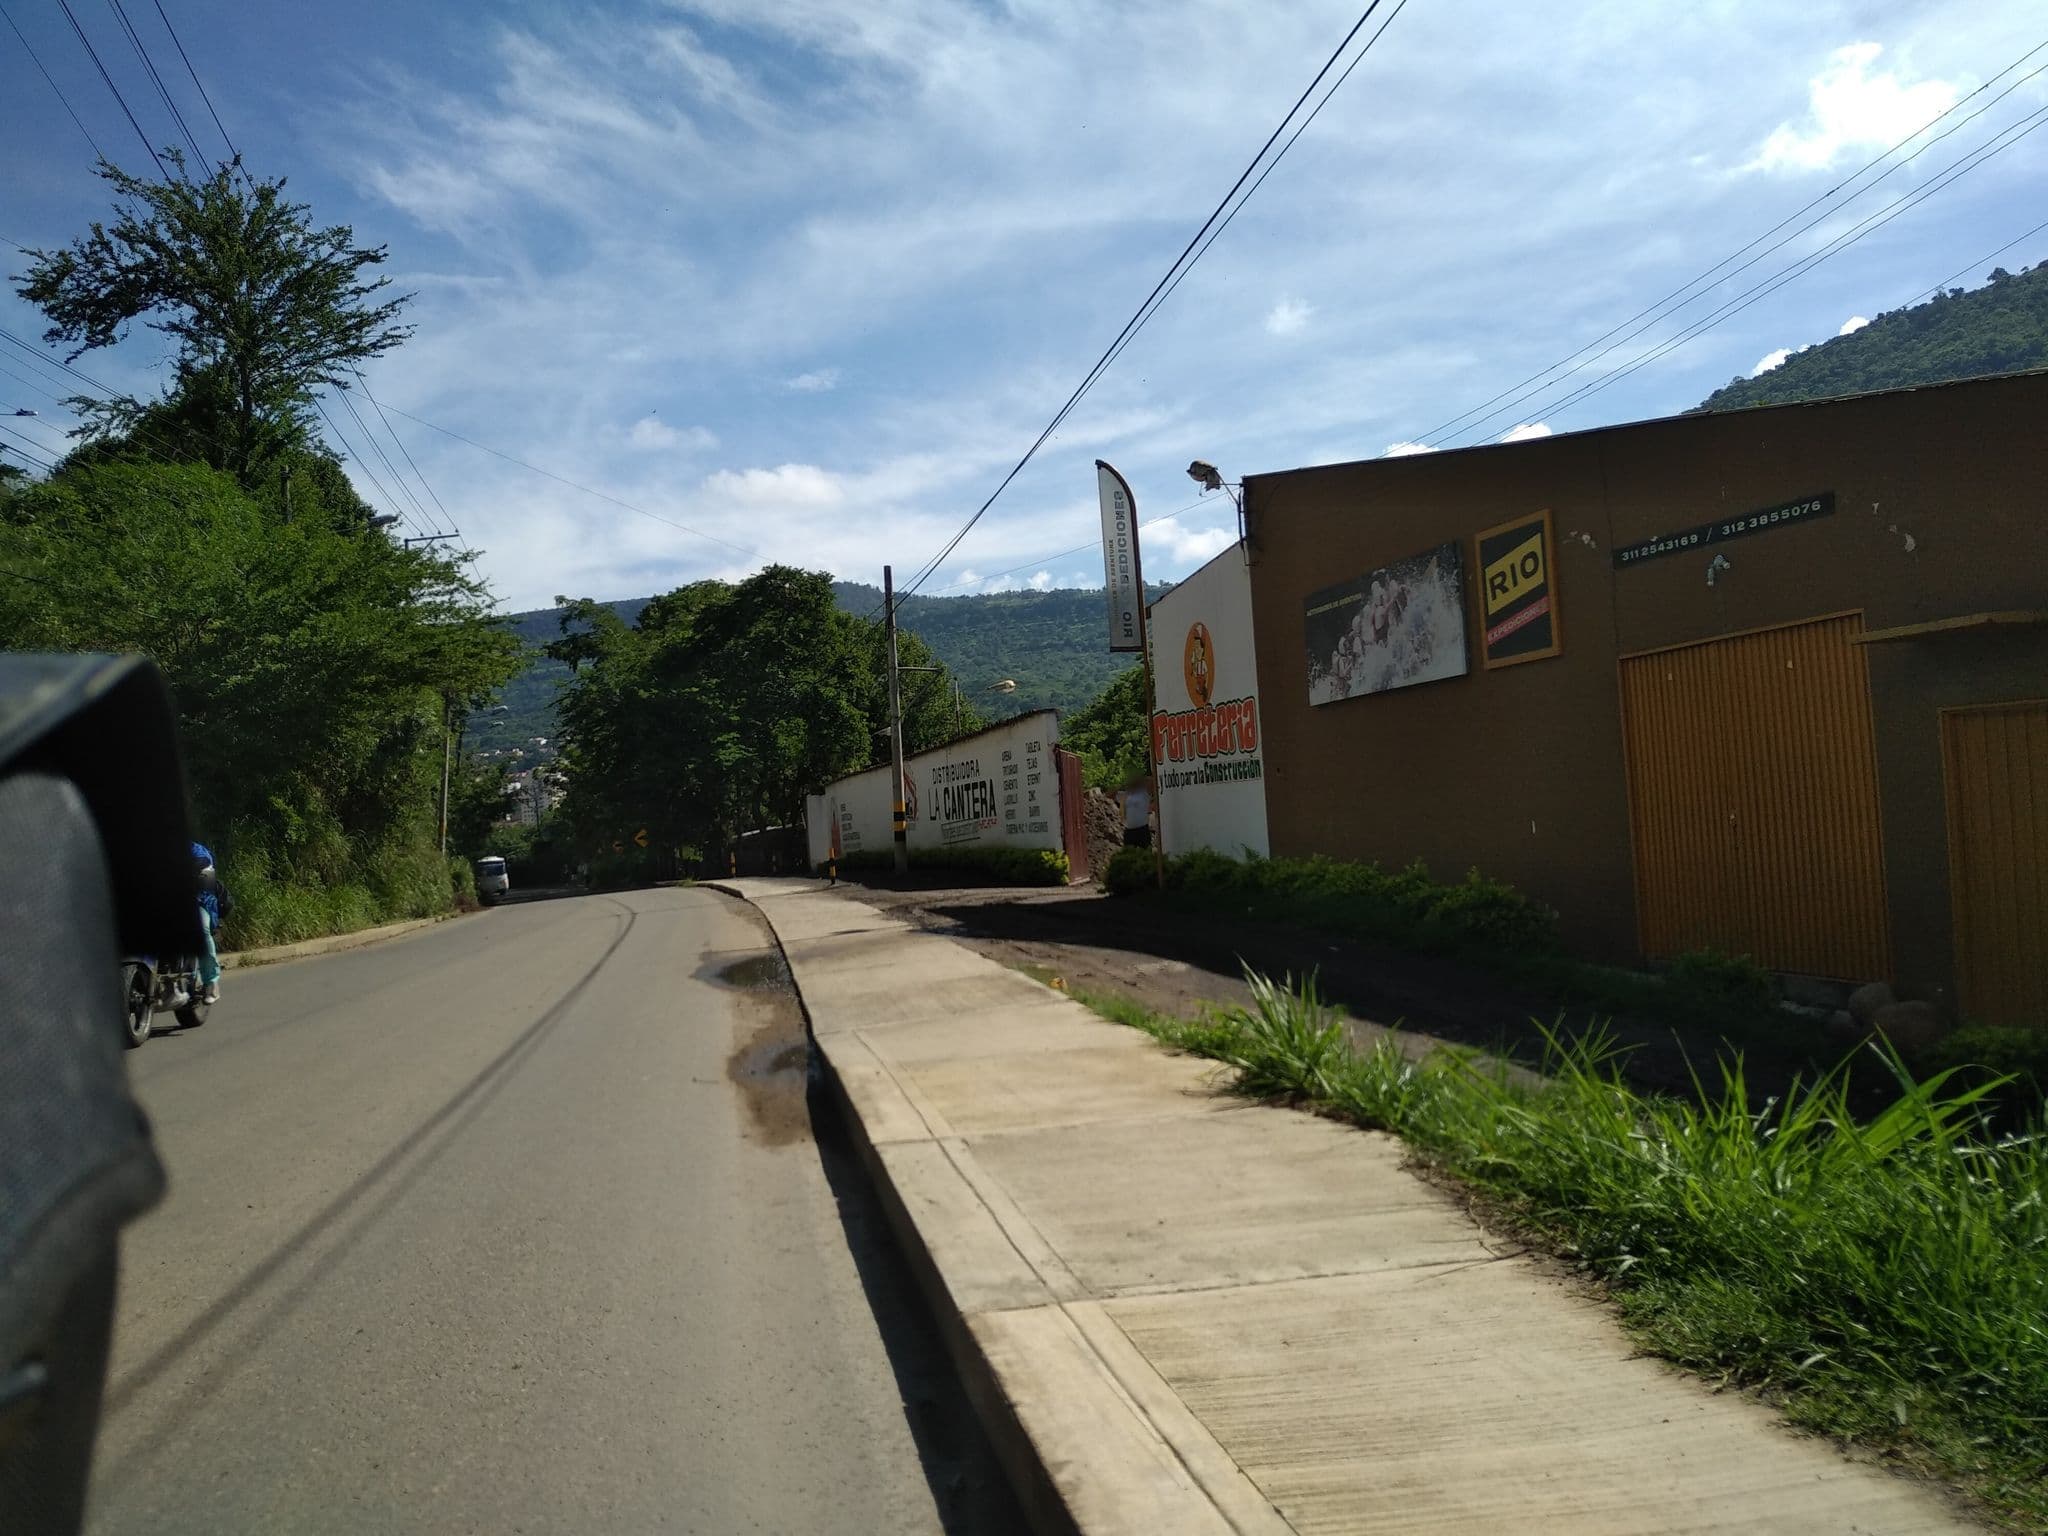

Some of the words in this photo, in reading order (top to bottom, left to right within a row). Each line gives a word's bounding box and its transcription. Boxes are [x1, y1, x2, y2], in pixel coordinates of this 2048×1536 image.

[1621, 534, 1698, 561] 3112543169
[1722, 521, 1745, 535] 312
[1749, 500, 1821, 528] 3855076
[1489, 551, 1539, 601] RIO
[932, 759, 981, 785] DISTRIBUIDORA
[1164, 768, 1180, 789] todo
[1181, 771, 1198, 790] para
[928, 787, 942, 821] LA
[943, 779, 997, 821] CANTERA
